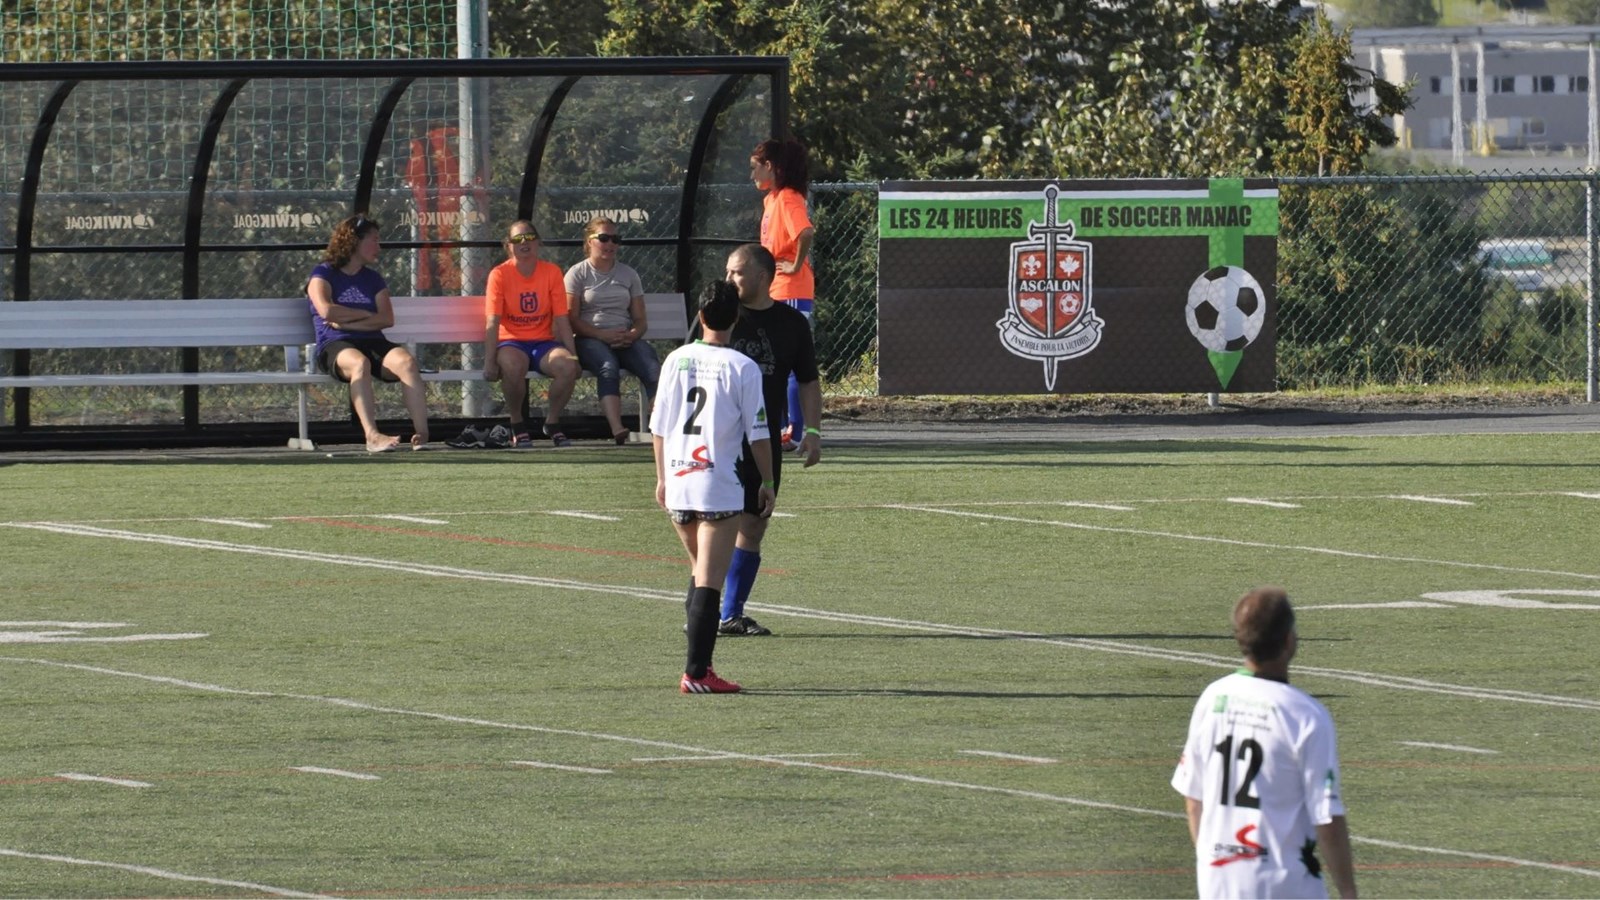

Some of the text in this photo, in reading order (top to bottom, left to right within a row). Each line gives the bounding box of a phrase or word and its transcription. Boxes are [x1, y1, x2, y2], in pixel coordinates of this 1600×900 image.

[889, 205, 1252, 230] LES 24 HEURES DE SOCCER MANAC
[1019, 280, 1080, 291] ASCALON
[1011, 335, 1040, 351] ENSEMBLE
[1040, 343, 1057, 352] POUR
[1057, 343, 1065, 351] LA
[683, 386, 707, 436] 2
[1214, 734, 1264, 810] 12
